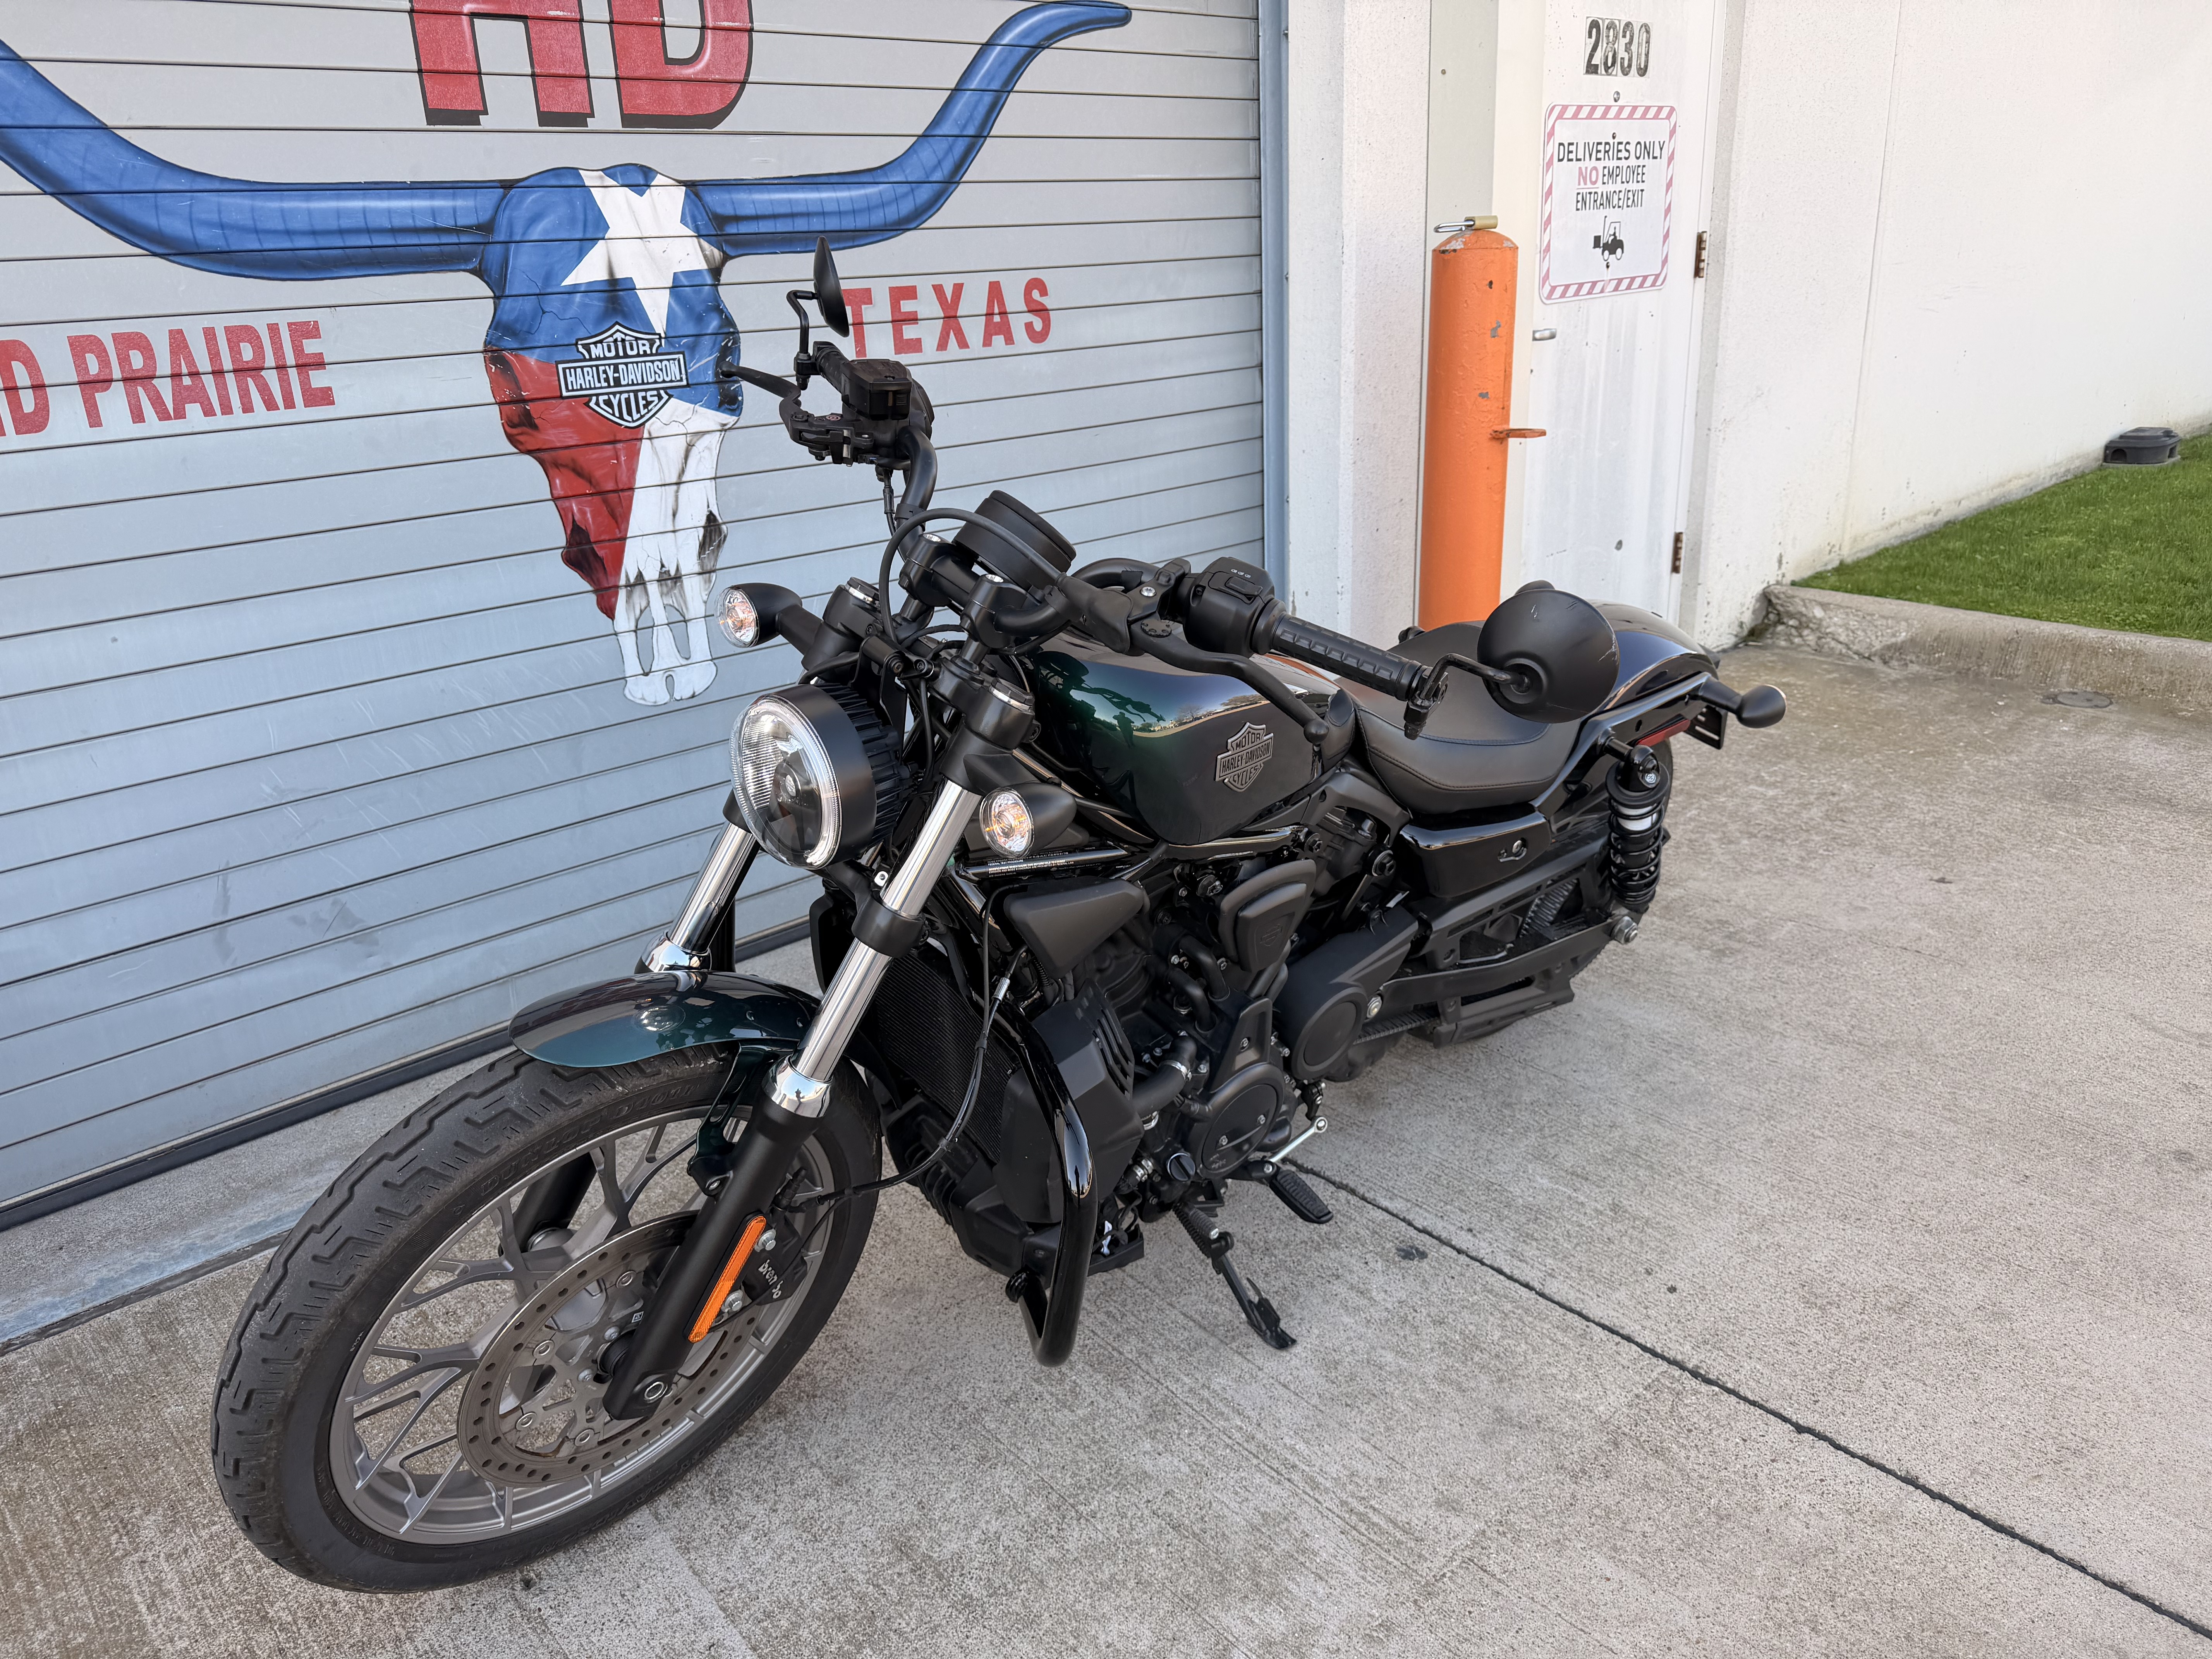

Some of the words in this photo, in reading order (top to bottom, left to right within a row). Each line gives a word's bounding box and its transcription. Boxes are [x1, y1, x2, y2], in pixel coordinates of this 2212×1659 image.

[1586, 19, 1651, 77] 2830
[1557, 141, 1631, 162] DELIVERIES
[1634, 141, 1665, 160] ONLY
[1577, 166, 1599, 187] NO
[1602, 165, 1645, 186] EMPLOYEE
[1575, 189, 1644, 212] ENTRANCE/EXIT
[841, 277, 1051, 358] TEXAS
[590, 331, 651, 358] MOTOR
[0, 338, 50, 436] D
[67, 320, 336, 428] PRAIRIE
[566, 360, 680, 390] HARLEY-DAVIDSON
[598, 390, 658, 422] CYCLES
[1236, 731, 1261, 750] MOTOR
[1222, 741, 1271, 774] HARLEY-DAVIDSON
[1233, 764, 1258, 786] CYCLES
[481, 1115, 601, 1196] DUNLOP
